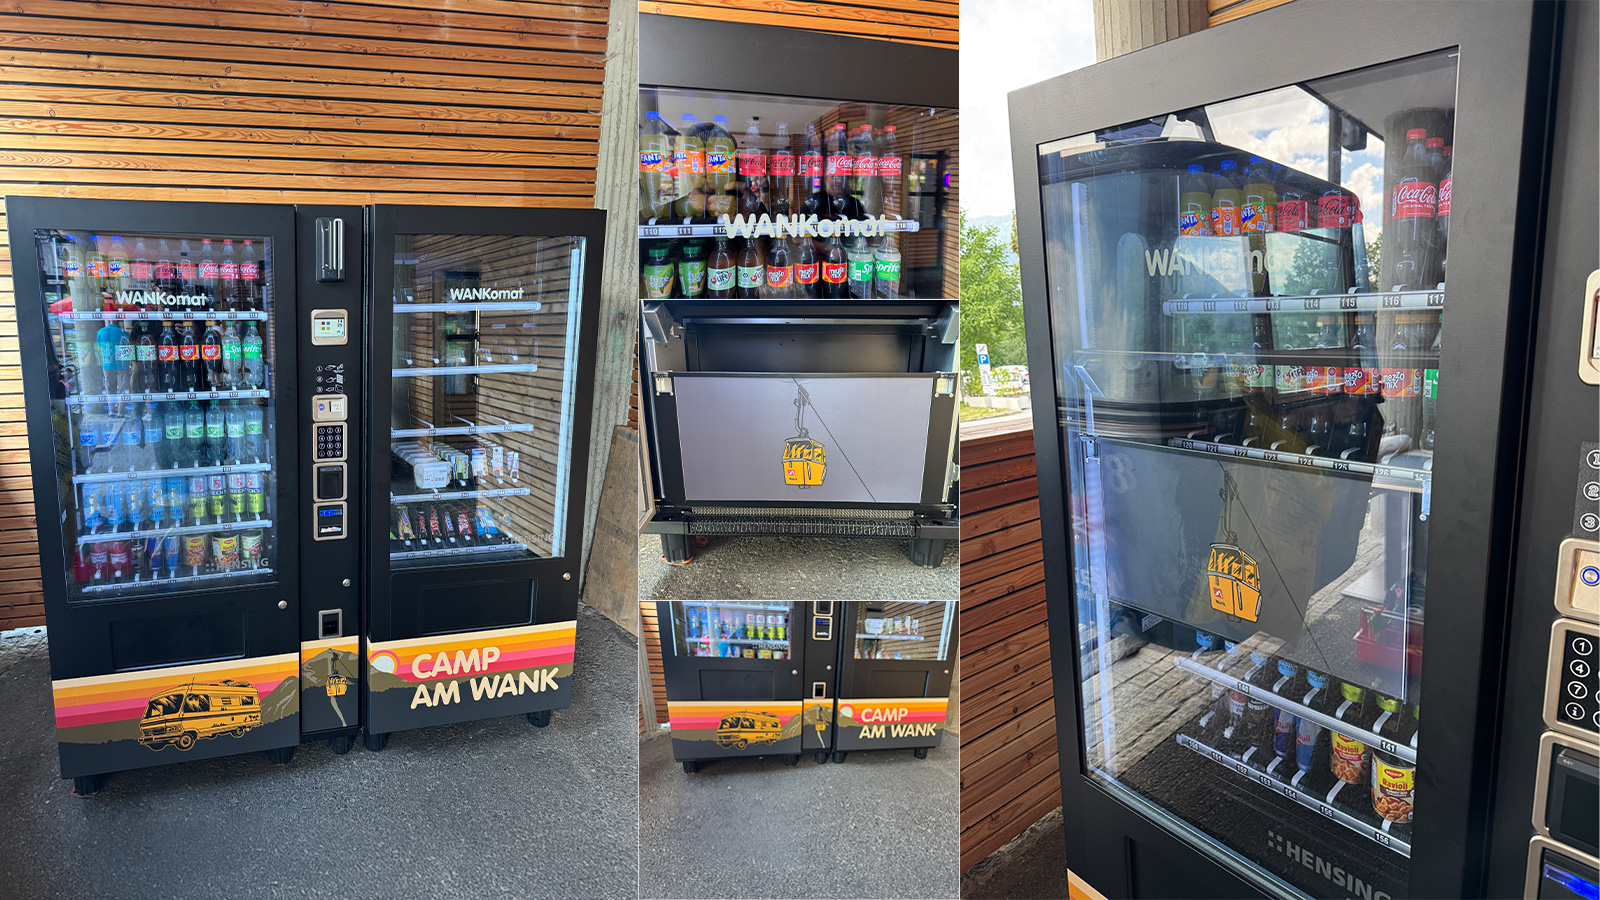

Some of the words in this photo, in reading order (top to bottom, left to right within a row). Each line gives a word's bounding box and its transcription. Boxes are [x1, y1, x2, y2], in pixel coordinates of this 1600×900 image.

[640, 153, 662, 163] FANTA
[1397, 185, 1437, 204] Coca-Cola
[722, 213, 888, 239] WANKomat
[875, 261, 900, 273] Sprite
[116, 291, 208, 306] WANKomat
[450, 287, 525, 301] WANKomat
[1177, 302, 1188, 310] 110
[1203, 302, 1216, 310] 111
[1234, 301, 1247, 310] 112
[1267, 300, 1280, 309] 113
[1305, 299, 1319, 308] 114
[1341, 298, 1355, 307] 115
[1384, 296, 1400, 305] 116
[1428, 294, 1445, 304] 117
[980, 355, 987, 363] P
[1383, 371, 1405, 383] mezzo
[1384, 379, 1399, 390] mix
[1182, 441, 1193, 450] 120
[1207, 445, 1218, 453] 121
[1236, 449, 1247, 457] 122
[1265, 453, 1277, 462] 123
[1334, 462, 1348, 471] 125
[1593, 452, 1600, 465] 1
[1588, 484, 1599, 497] 2
[1584, 516, 1595, 528] 3
[217, 558, 269, 571] HENSING
[1580, 641, 1585, 652] 1
[411, 646, 500, 679] CAMP
[1575, 664, 1584, 674] 4
[410, 680, 461, 709] AM
[469, 667, 559, 701] WANK
[1238, 682, 1249, 692] 140
[1573, 685, 1582, 695] 7
[861, 707, 908, 722] CAMP
[859, 725, 886, 739] AM
[890, 723, 937, 737] WANK
[1336, 741, 1359, 753] Ravioli
[1381, 741, 1396, 752] 141
[1382, 778, 1408, 790] Ravioli
[1189, 740, 1199, 750] 150
[1212, 752, 1222, 761] 151
[1237, 764, 1248, 774] 152
[1260, 776, 1271, 786] 153
[1284, 788, 1296, 799] 154
[1320, 806, 1333, 817] 155
[1375, 833, 1389, 845] 156
